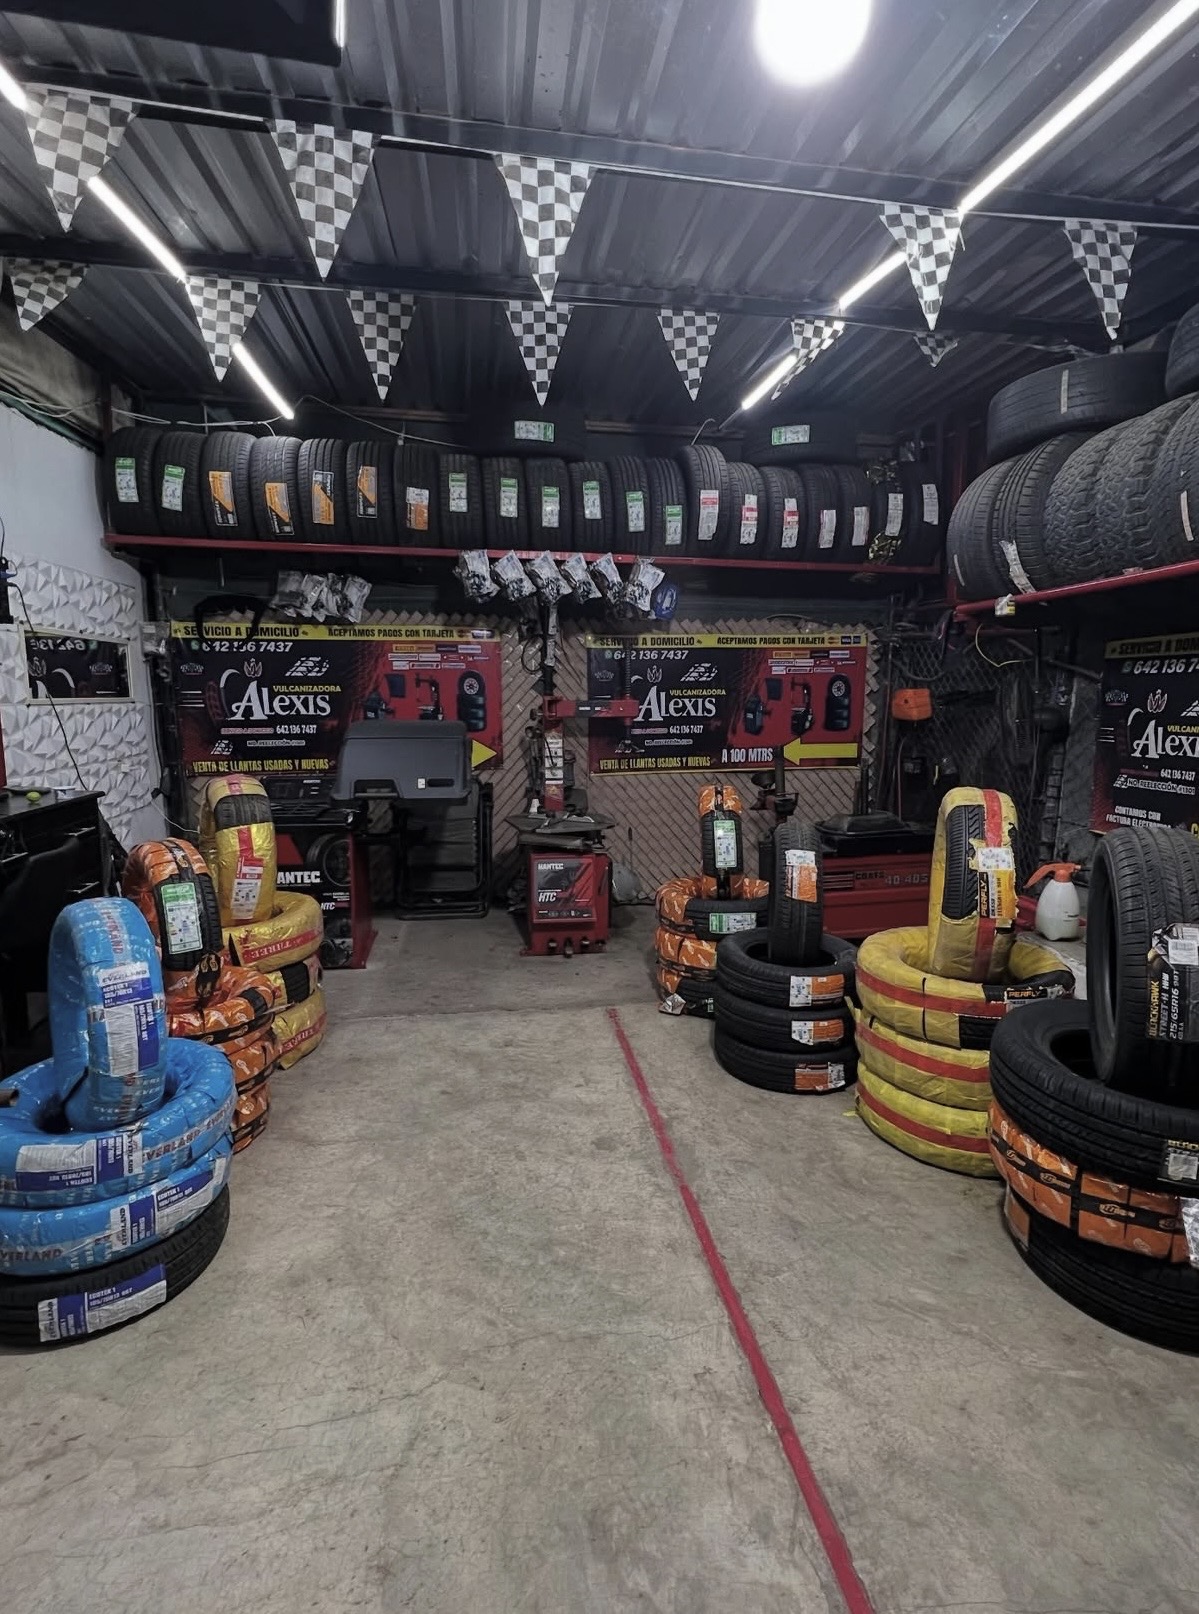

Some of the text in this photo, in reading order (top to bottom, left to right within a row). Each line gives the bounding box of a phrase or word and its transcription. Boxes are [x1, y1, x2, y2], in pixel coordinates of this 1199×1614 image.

[184, 625, 232, 637] SEVICIO
[235, 626, 242, 636] A
[378, 629, 403, 638] PAGOS
[405, 629, 420, 638] CON
[422, 629, 454, 638] TARJETA
[642, 638, 648, 646] A
[650, 636, 695, 646] DOMICILIO
[717, 636, 825, 645] ACEPTAMOS PAGOS CON TARJETA
[260, 641, 294, 653] 7437
[639, 650, 659, 660] 136
[660, 650, 689, 660] 7437
[1133, 660, 1159, 674] 642
[1161, 659, 1186, 673] 136
[272, 685, 342, 694] VULCANIZADORA
[276, 725, 289, 734] 642
[290, 725, 301, 734] 136
[302, 724, 317, 734] 7437
[721, 748, 773, 763] A 100 MTRS
[193, 761, 217, 772] VENTA
[218, 761, 229, 772] DE
[230, 760, 262, 772] LLANTAS
[264, 759, 293, 771] USADAS
[301, 758, 329, 770] NUEVAS
[600, 759, 619, 770] VENTA
[620, 759, 629, 769] DE
[630, 758, 656, 769] LLANTAS
[657, 757, 681, 768] USADAS
[687, 756, 711, 767] NUEVAS
[1160, 768, 1172, 779] 642
[1114, 805, 1162, 822] CONTAMOS CON
[1105, 814, 1132, 827] FACTURA
[538, 863, 564, 871] HANTEC
[276, 871, 321, 884] ANTEC
[538, 892, 557, 903] HTC
[980, 880, 988, 917] PERFLY
[1008, 990, 1041, 998] PERFLY
[1169, 987, 1180, 1039] 215/65R16
[0, 1248, 63, 1261] VERLAND
